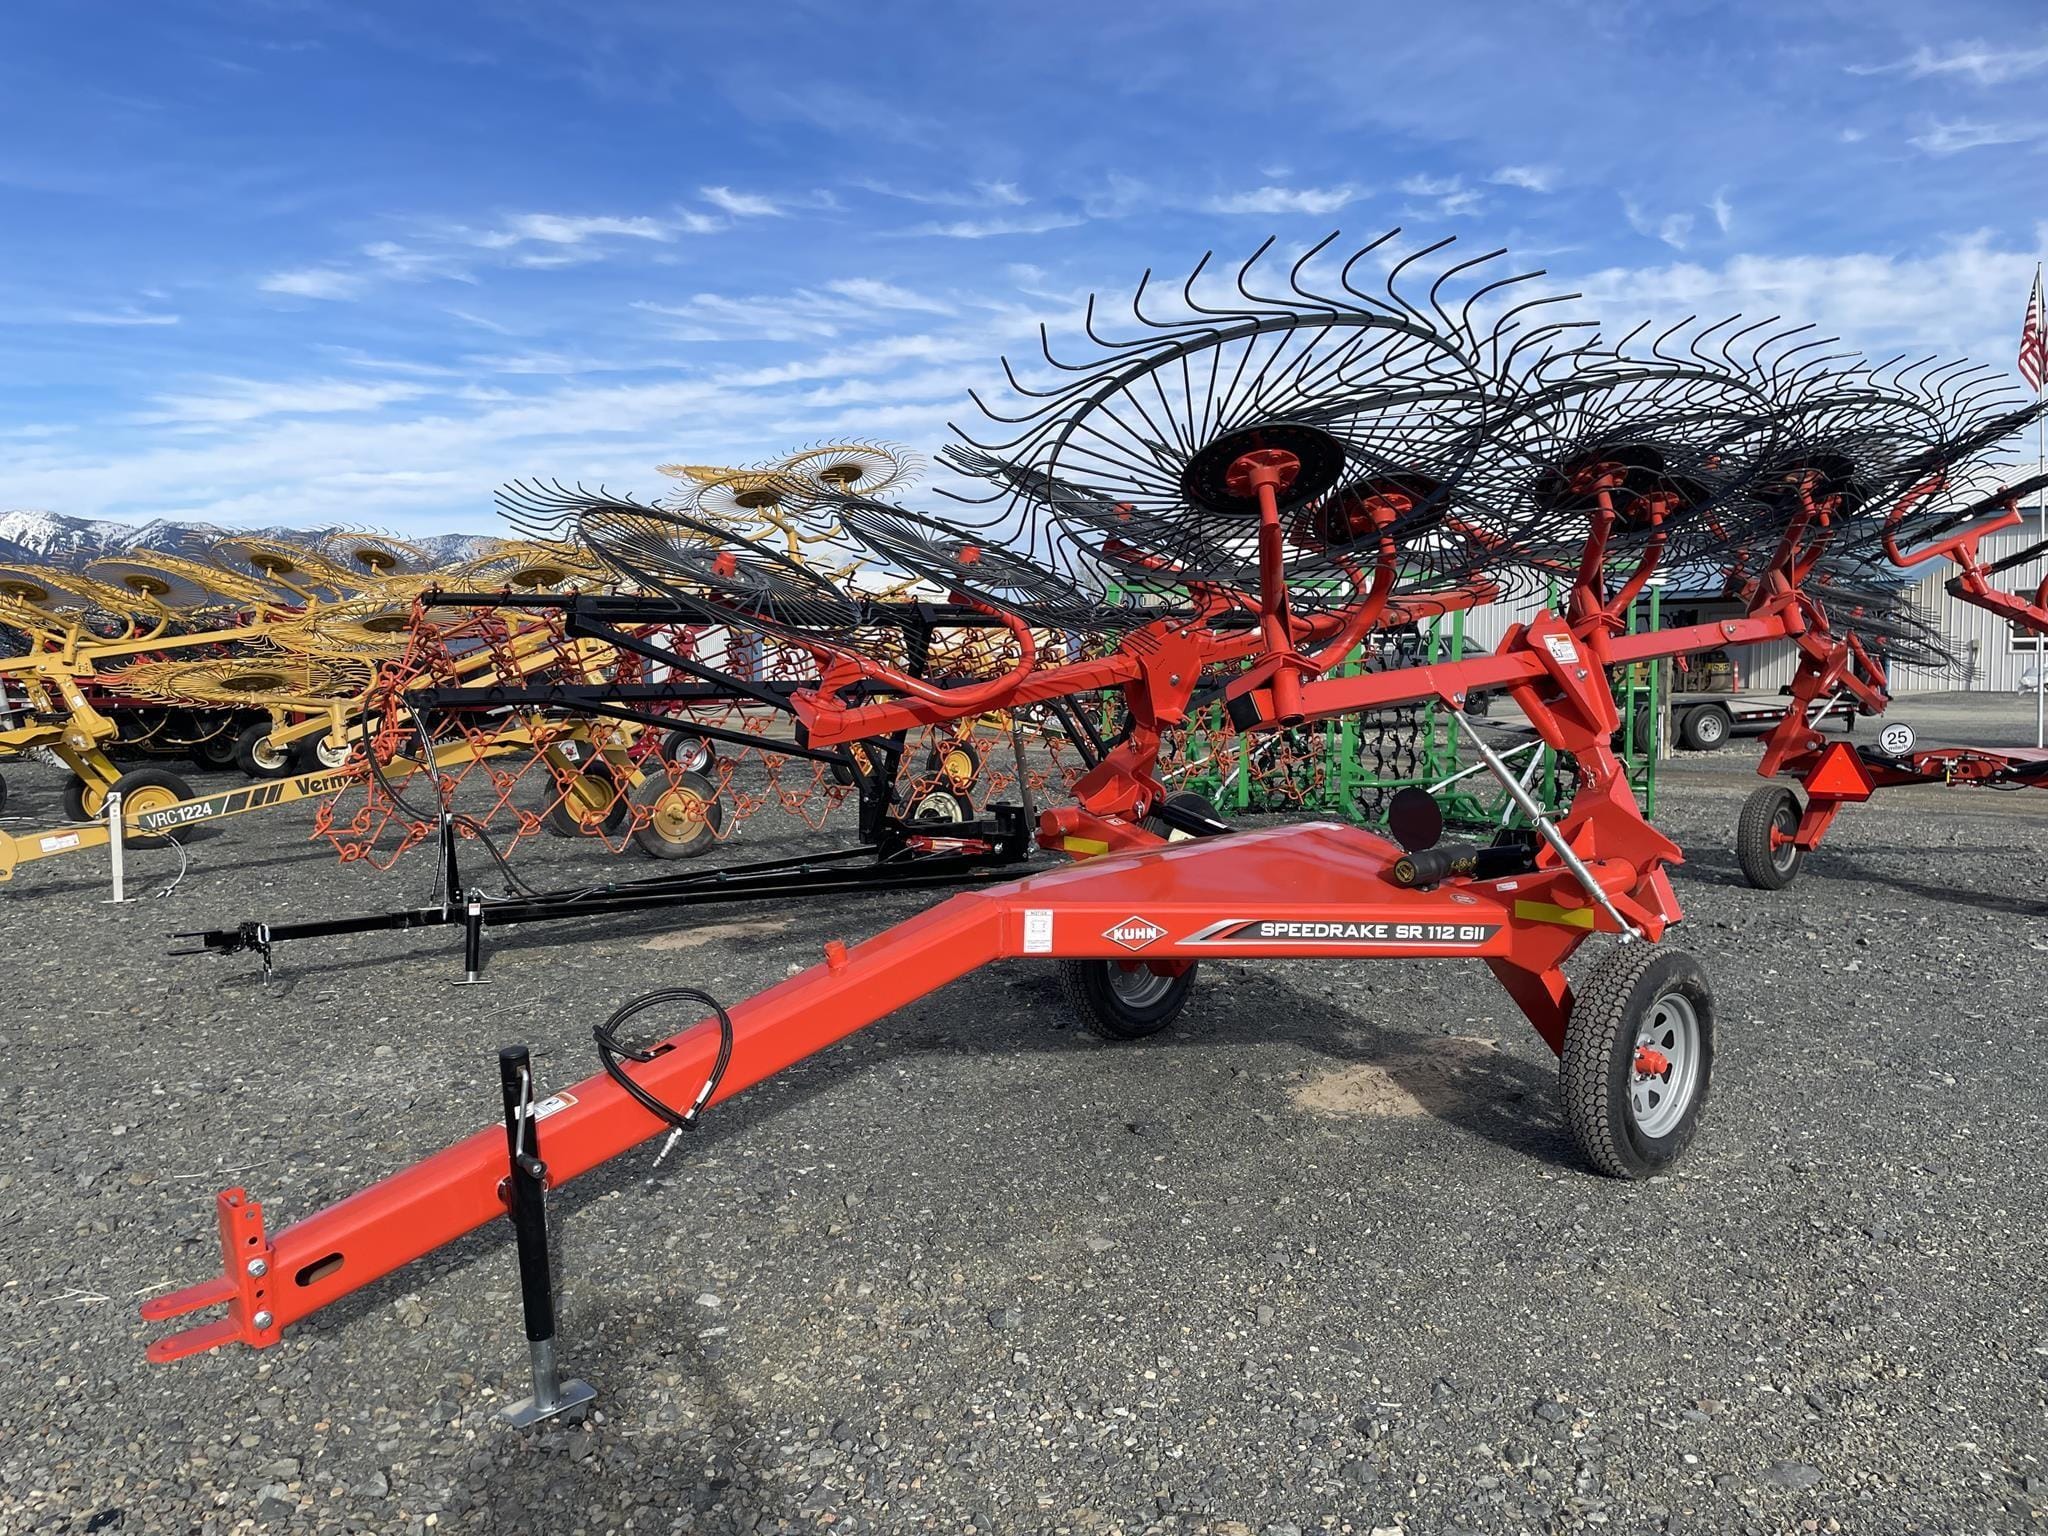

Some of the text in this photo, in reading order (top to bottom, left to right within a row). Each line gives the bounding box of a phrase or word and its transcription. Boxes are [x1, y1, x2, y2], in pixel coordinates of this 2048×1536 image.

[1887, 731, 1908, 745] 25
[146, 801, 213, 829] VRC1224
[1113, 927, 1157, 941] KUHN
[1260, 922, 1485, 940] SPEEDRAKE SR 112 GII
